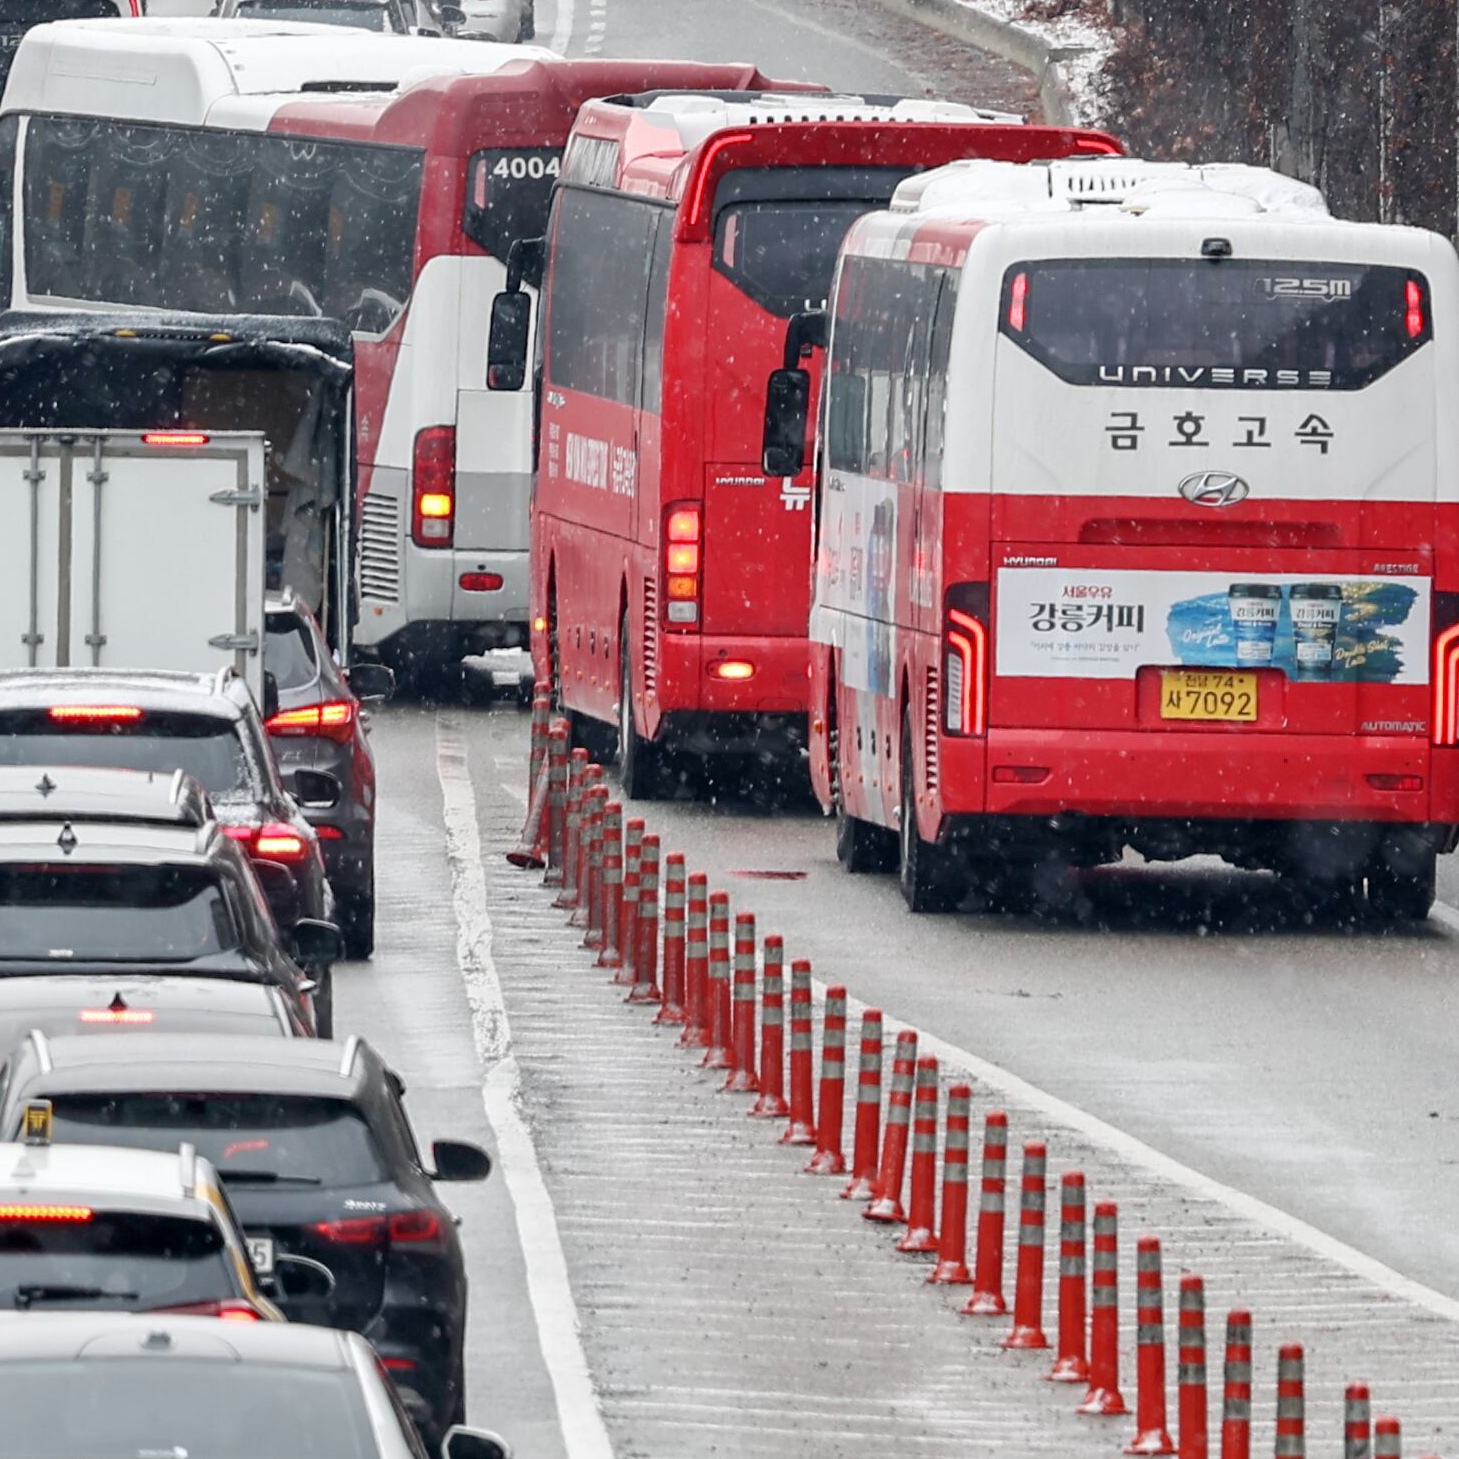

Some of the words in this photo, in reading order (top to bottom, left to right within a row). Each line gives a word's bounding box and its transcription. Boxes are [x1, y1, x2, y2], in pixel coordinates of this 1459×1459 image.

[493, 156, 561, 180] 4004
[1099, 365, 1333, 387] UNIVERSE
[1003, 556, 1058, 567] HYUNDAI
[1374, 563, 1419, 574] PRESTIGE
[1062, 585, 1114, 599] 서울우유
[1029, 602, 1145, 634] 강릉커피
[1185, 675, 1208, 688] 전남
[1213, 675, 1234, 688] 74
[1187, 691, 1252, 715] 7092
[1361, 721, 1426, 733] AUTOMATIC
